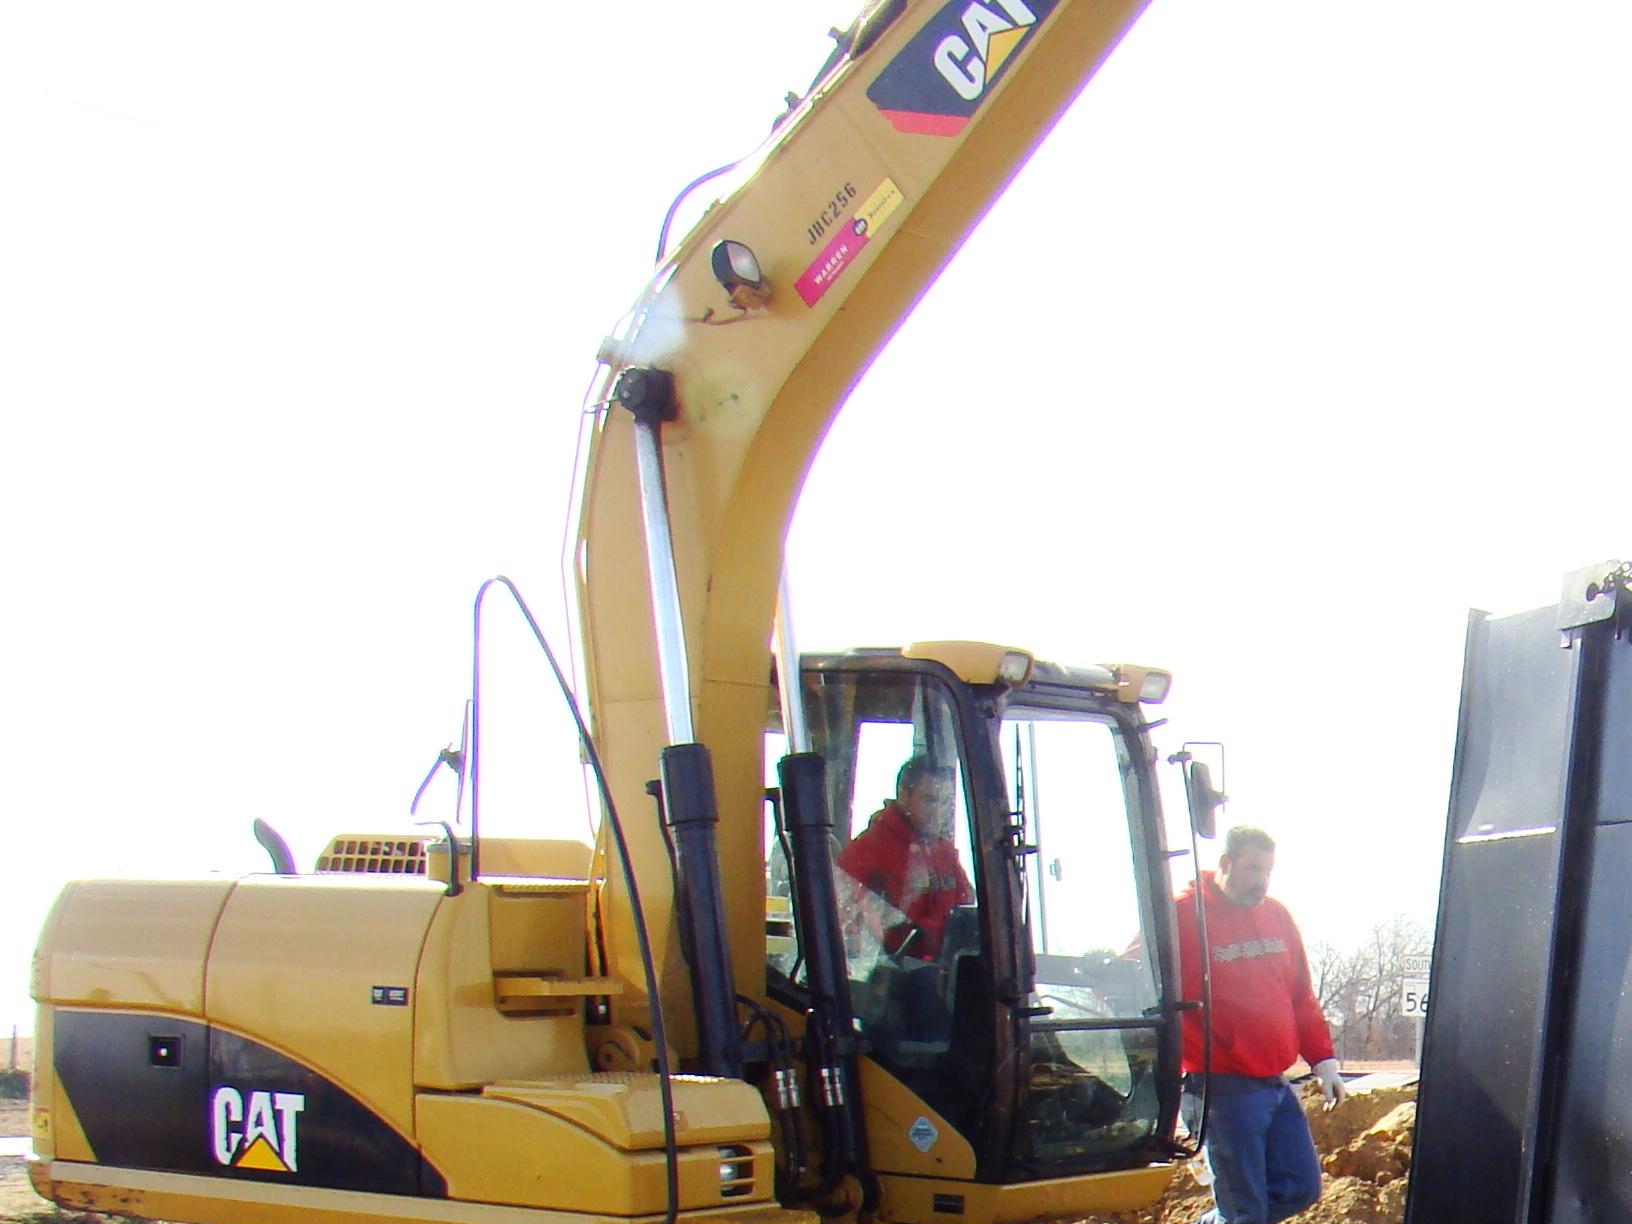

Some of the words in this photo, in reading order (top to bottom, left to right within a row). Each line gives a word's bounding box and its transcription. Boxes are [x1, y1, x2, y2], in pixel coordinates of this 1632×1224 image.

[807, 182, 857, 245] JBC256
[813, 244, 849, 285] WARREN
[1406, 958, 1430, 971] SOUT
[213, 1086, 305, 1173] CAT
